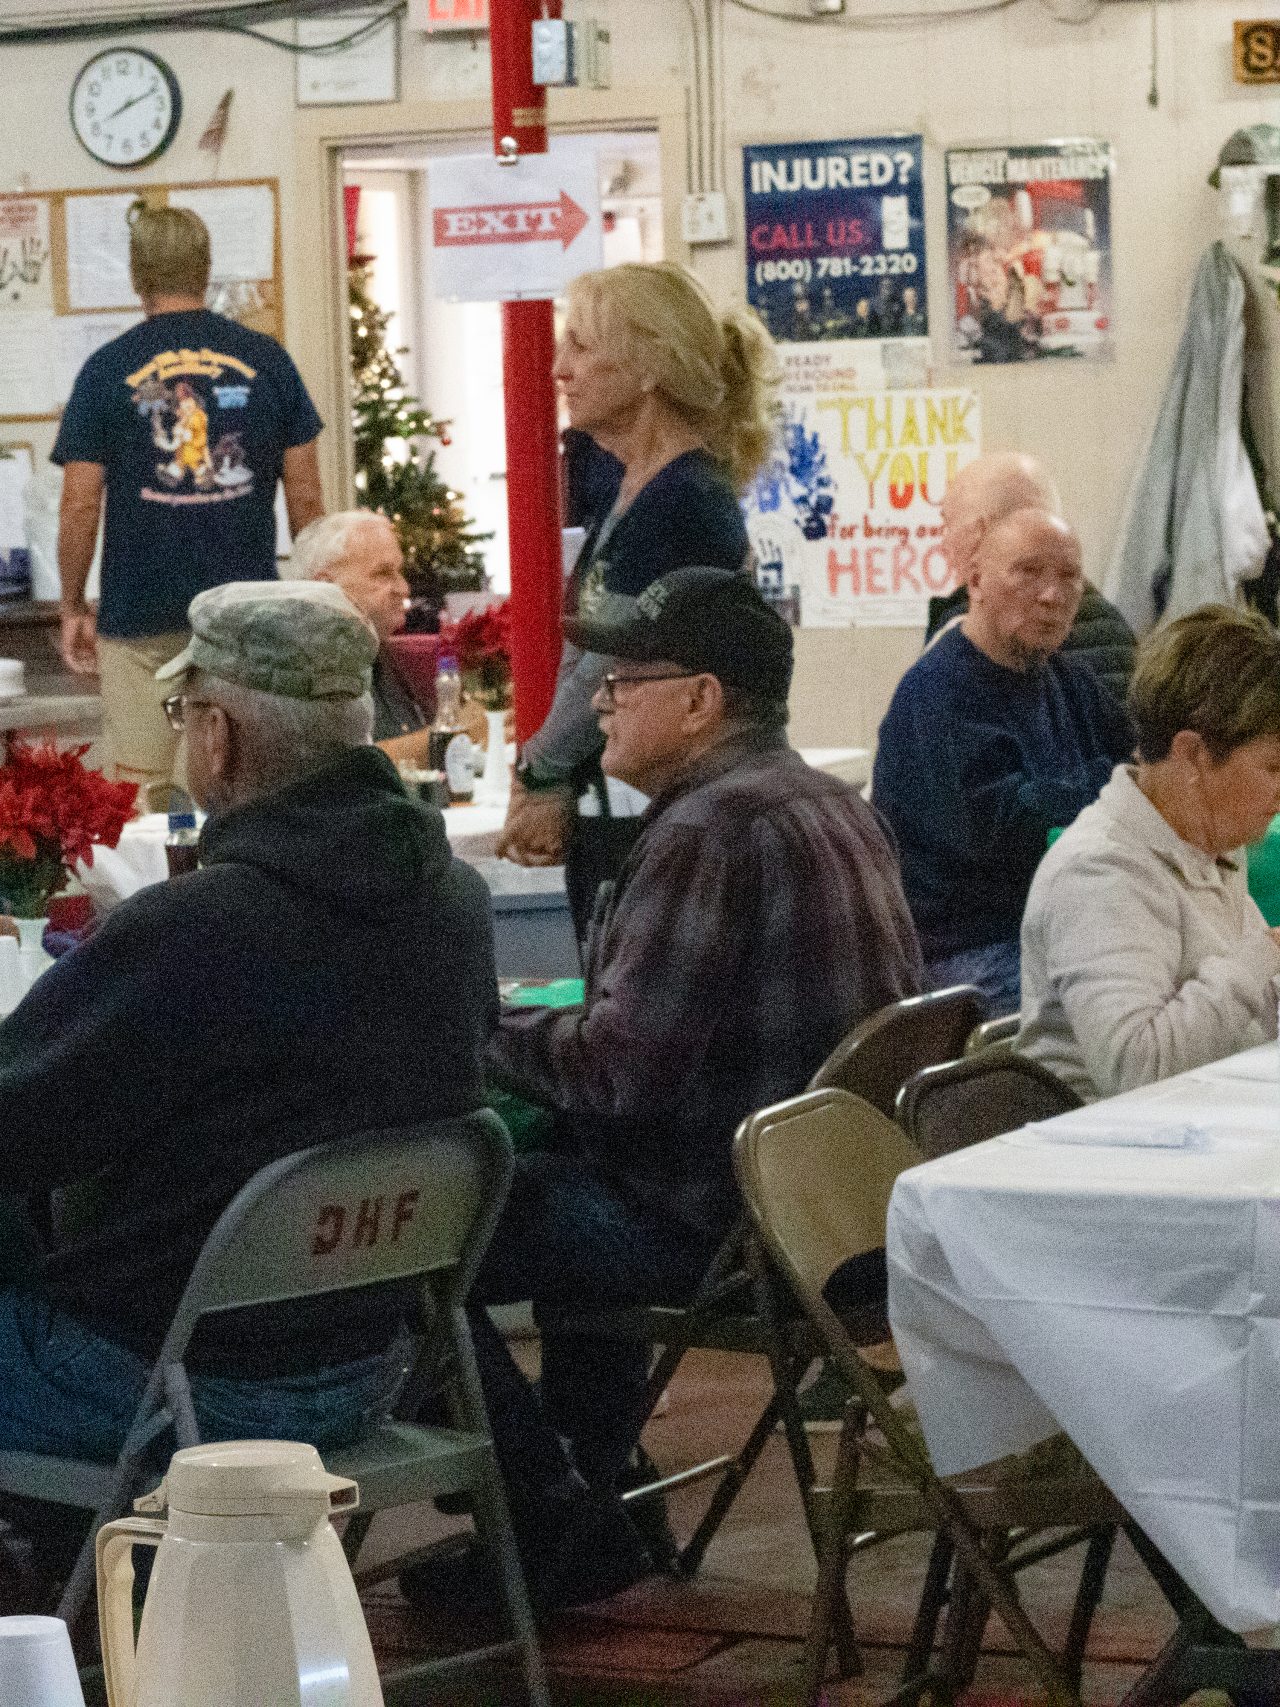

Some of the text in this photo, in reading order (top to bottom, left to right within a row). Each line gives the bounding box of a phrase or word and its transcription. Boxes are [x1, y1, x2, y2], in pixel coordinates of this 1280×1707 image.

[115, 58, 130, 76] 12
[88, 81, 102, 97] 10
[85, 101, 96, 118] 9
[155, 95, 165, 112] 3
[152, 116, 162, 131] 4
[104, 133, 114, 152] 7
[121, 137, 133, 156] 6
[139, 129, 151, 149] 5
[751, 153, 914, 193] INJURED?
[444, 207, 563, 237] EXIT
[751, 222, 814, 250] CALL
[755, 253, 917, 286] (800) 781-2320
[816, 395, 976, 457] THANK
[854, 451, 958, 510] YOU
[828, 513, 858, 539] for
[863, 513, 910, 546] being
